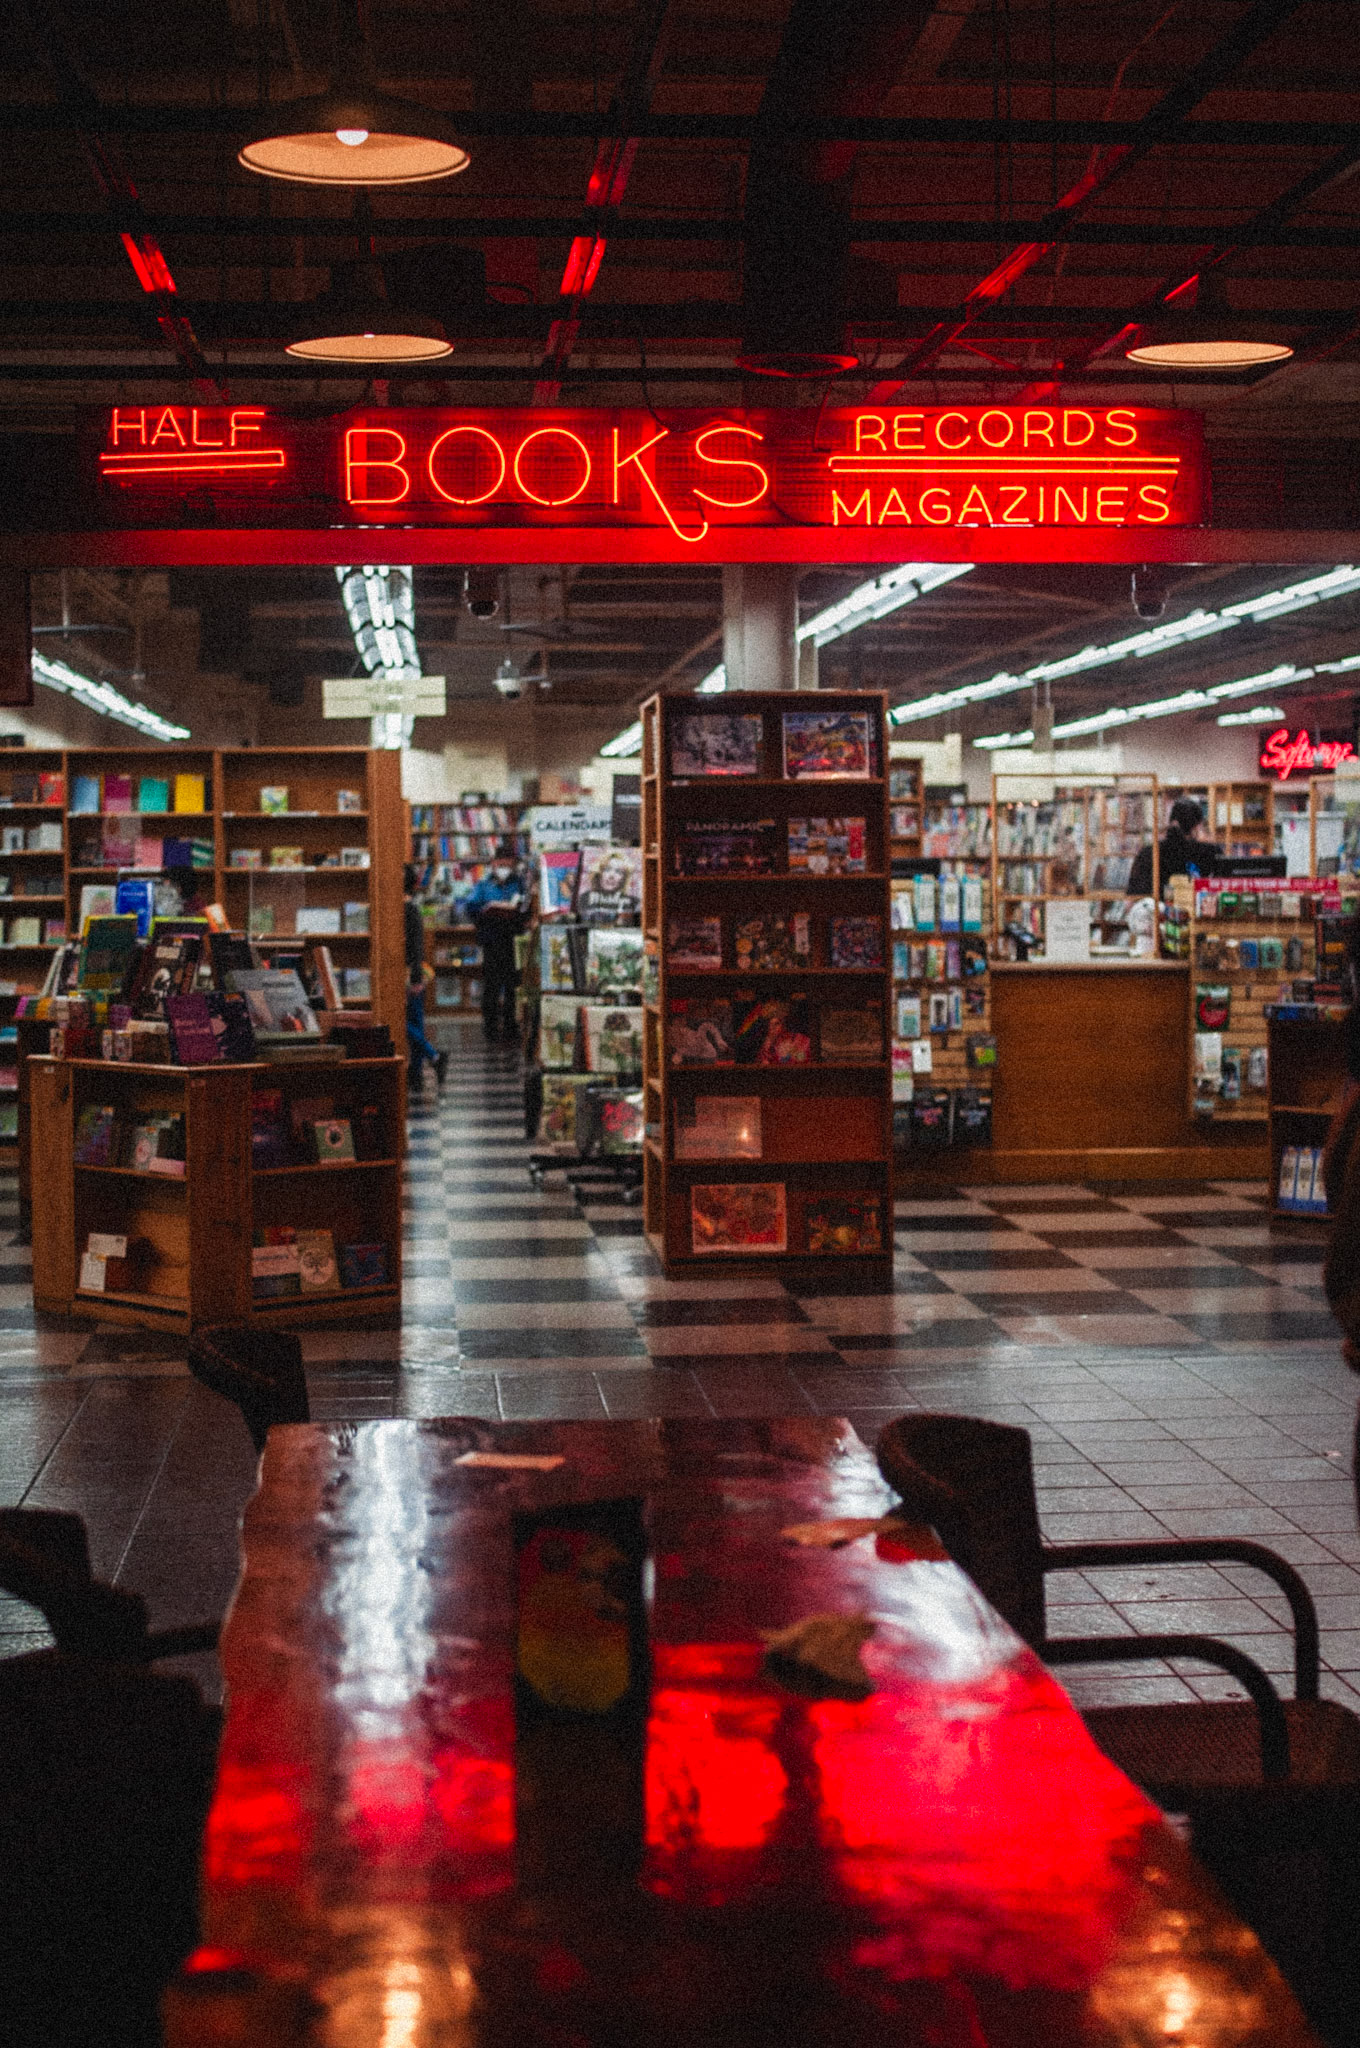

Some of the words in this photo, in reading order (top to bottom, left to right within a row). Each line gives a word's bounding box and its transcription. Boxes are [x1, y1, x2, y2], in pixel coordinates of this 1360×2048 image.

[112, 407, 266, 447] HALF
[854, 409, 1139, 452] RECORDS
[345, 425, 770, 543] BOOKS
[831, 485, 1171, 526] MAGAZINES
[536, 819, 613, 832] CALENDAR
